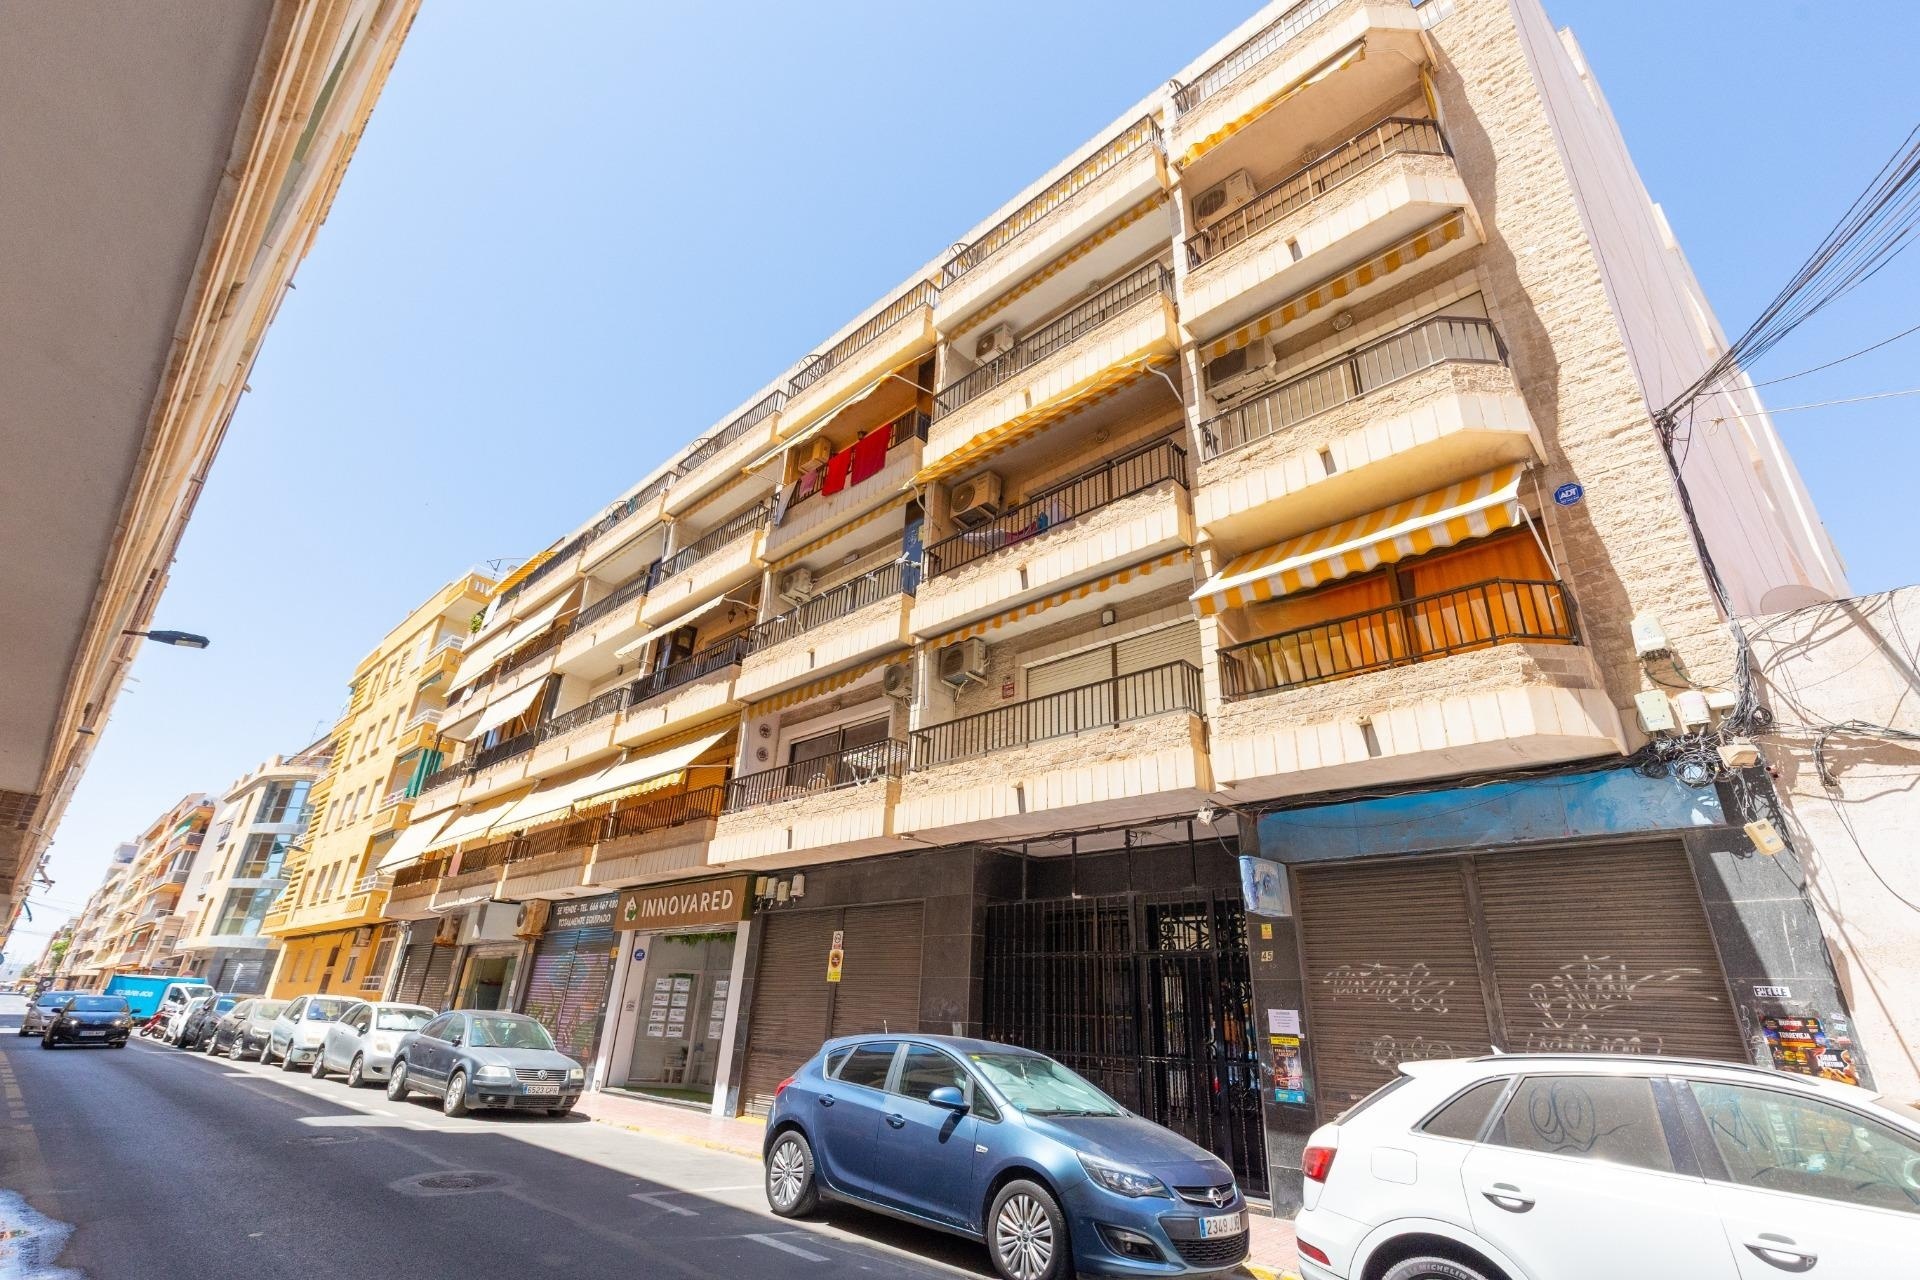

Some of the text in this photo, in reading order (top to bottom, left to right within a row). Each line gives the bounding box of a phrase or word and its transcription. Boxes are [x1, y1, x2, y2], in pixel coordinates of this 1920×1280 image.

[1560, 488, 1577, 499] ADT
[563, 904, 577, 914] VENDE
[589, 902, 598, 911] 666
[641, 889, 733, 918] INNOVARED
[586, 914, 611, 925] EQUIPADO
[1262, 951, 1273, 961] 45
[1778, 1032, 1811, 1040] TORREVIEJA
[1206, 1218, 1228, 1235] 2349
[1419, 1263, 1467, 1280] MICHELIN
